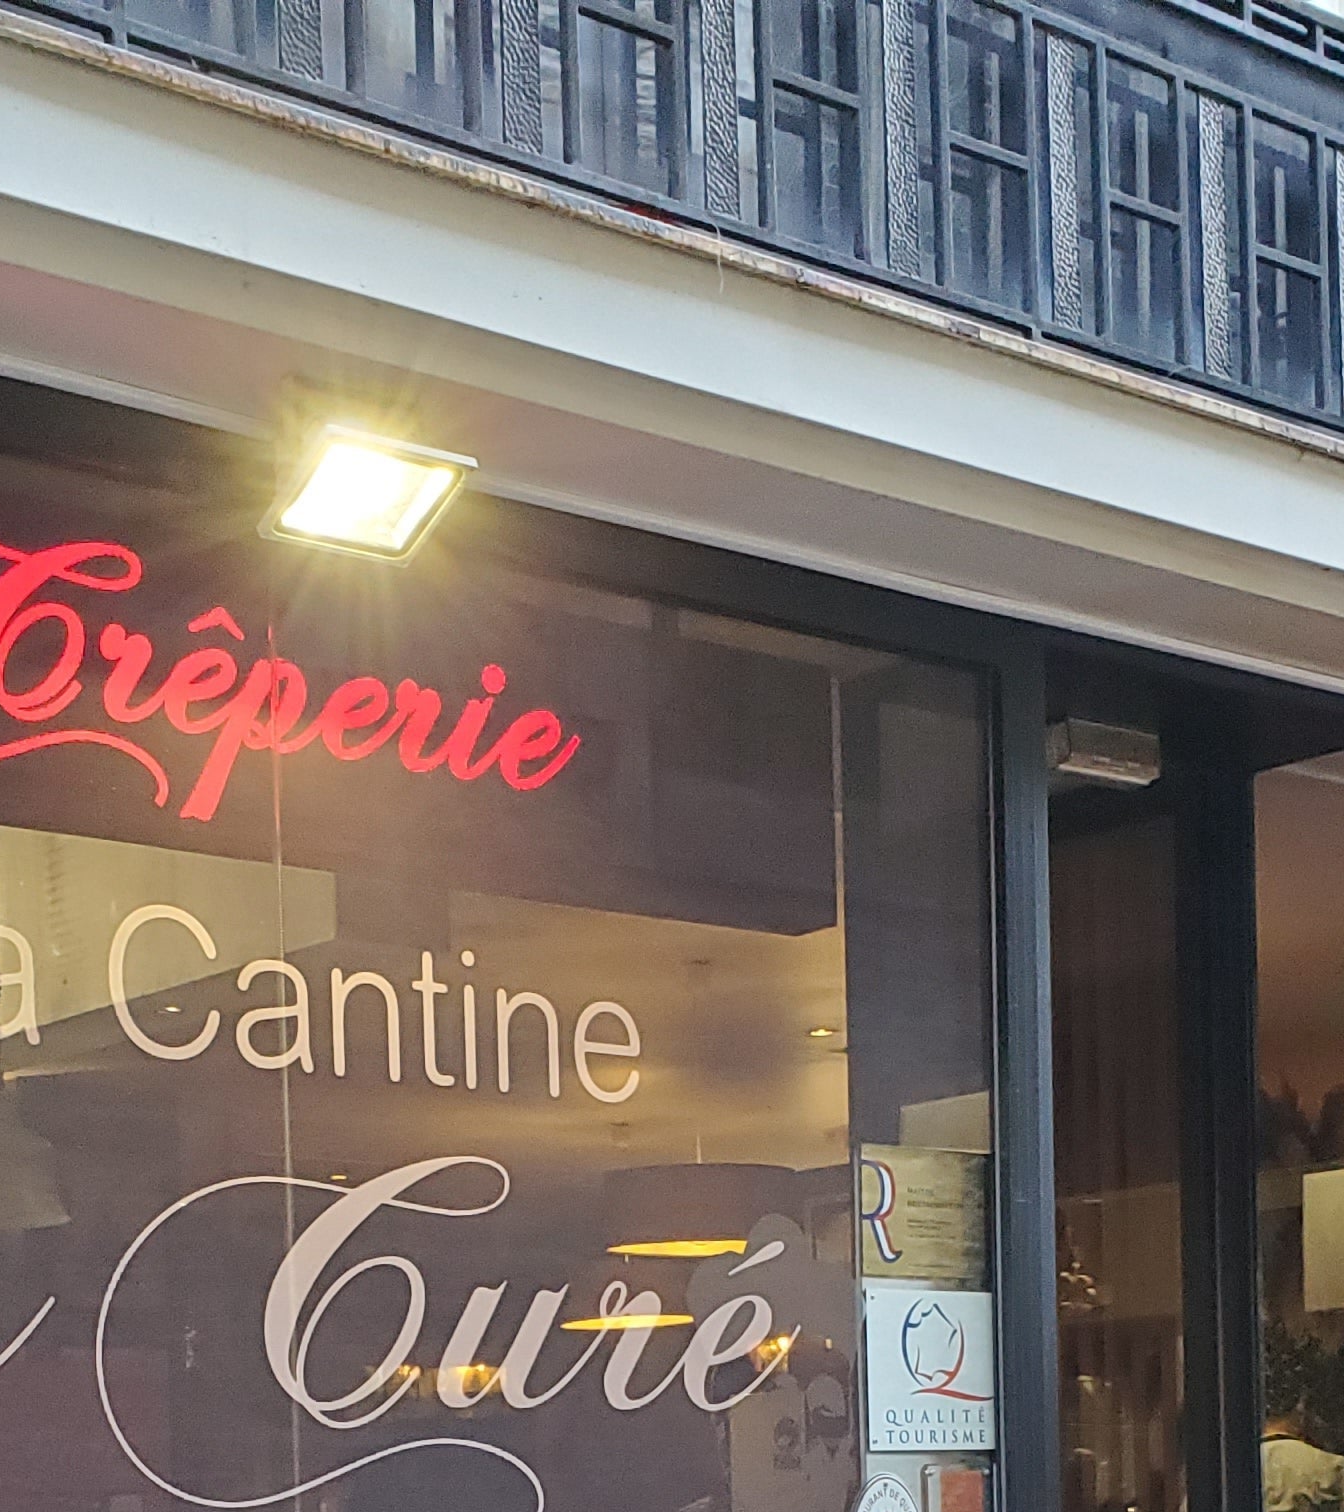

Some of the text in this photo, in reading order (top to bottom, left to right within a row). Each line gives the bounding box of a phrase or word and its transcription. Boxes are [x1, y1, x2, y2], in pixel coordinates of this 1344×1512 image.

[108, 903, 642, 1104] Cantine
[885, 1429, 987, 1444] TOURISME
[888, 1487, 901, 1501] DE
